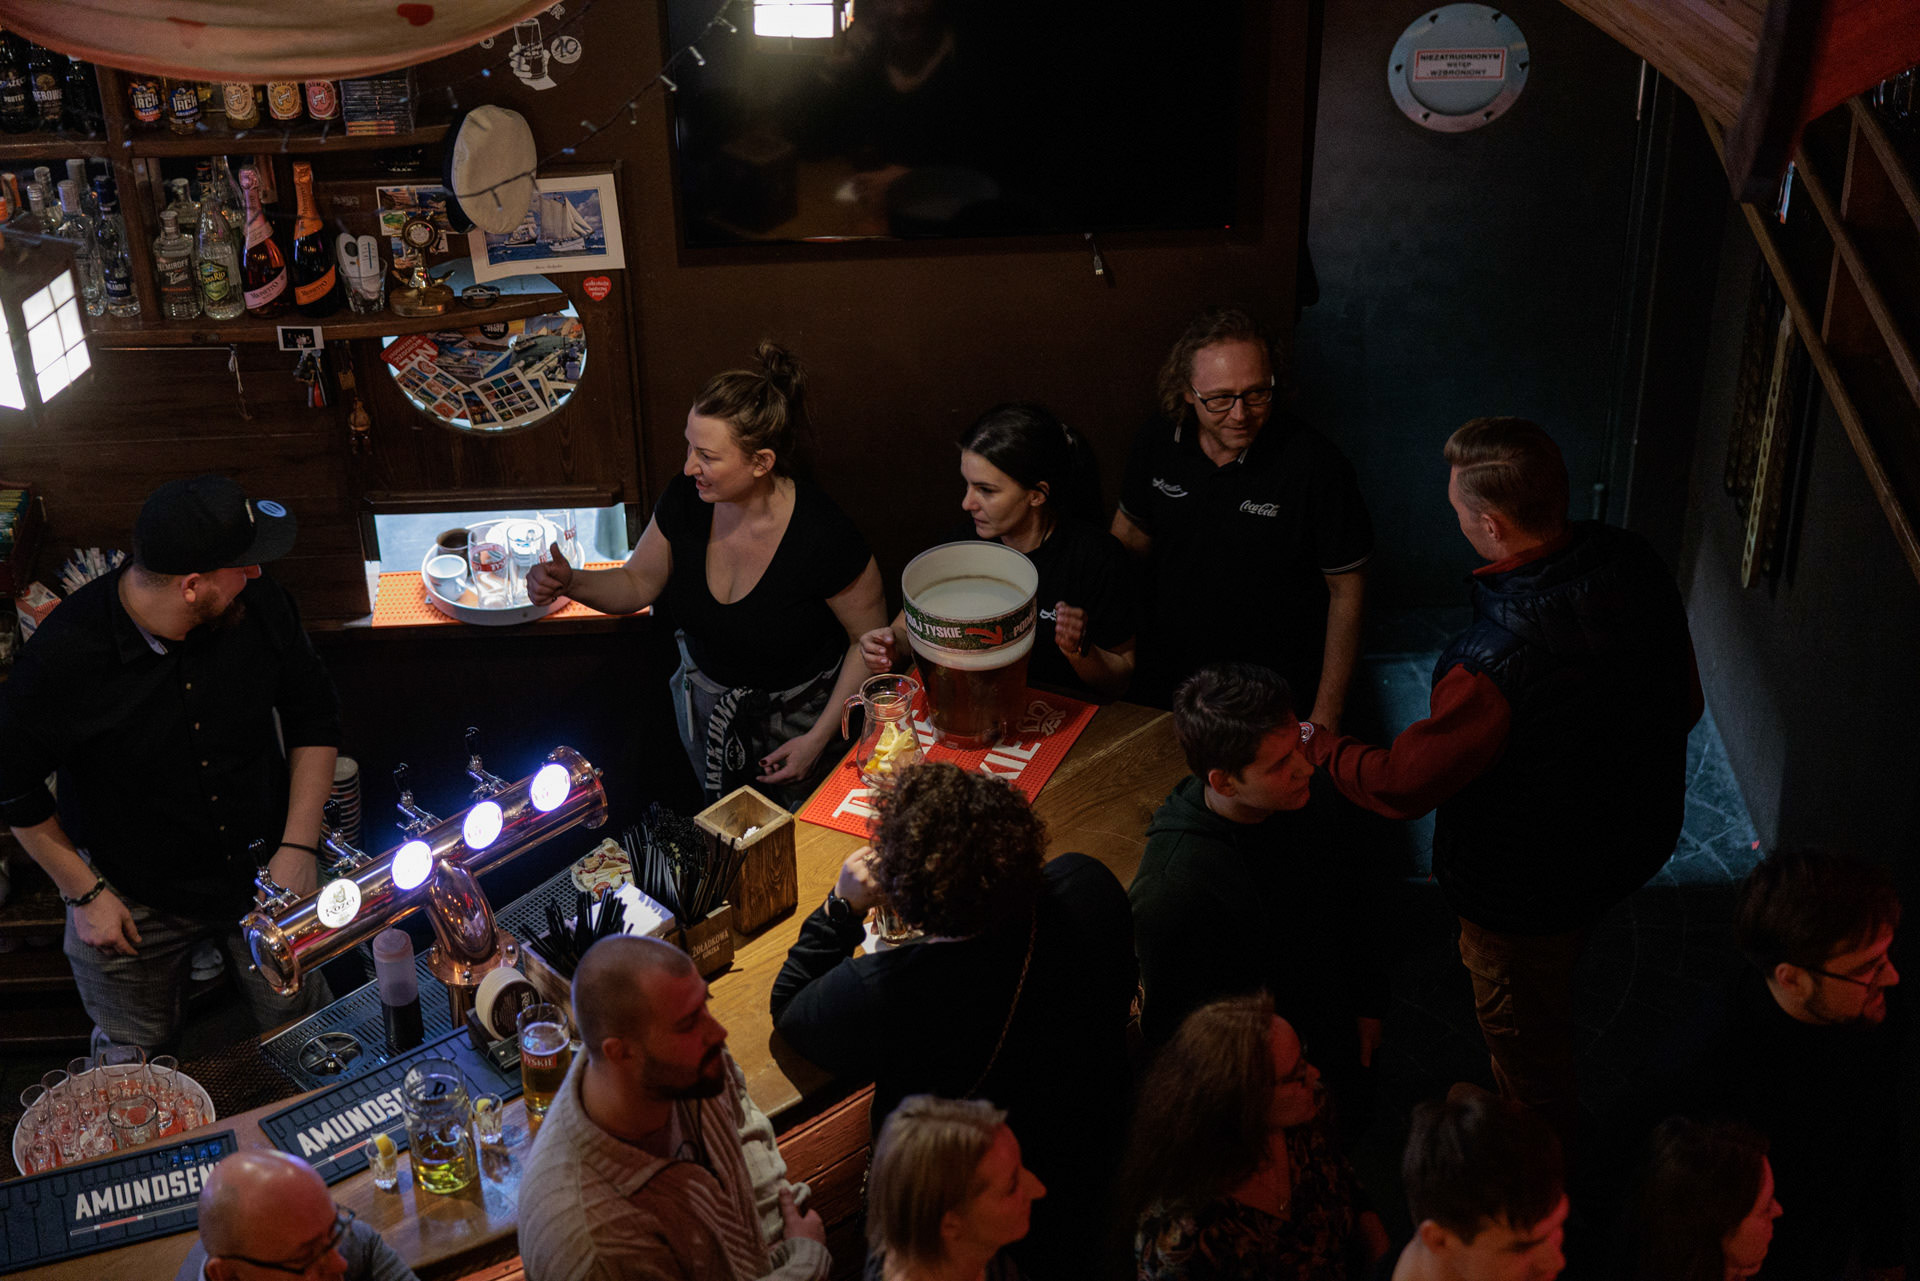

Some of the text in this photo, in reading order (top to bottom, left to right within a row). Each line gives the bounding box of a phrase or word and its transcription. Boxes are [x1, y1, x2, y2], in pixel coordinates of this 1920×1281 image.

[1420, 53, 1500, 61] NIEZATRUDNIONYM
[1239, 499, 1280, 517] Coca-Cola
[923, 622, 963, 639] TYSKIE
[523, 1054, 554, 1067] TYSKIE
